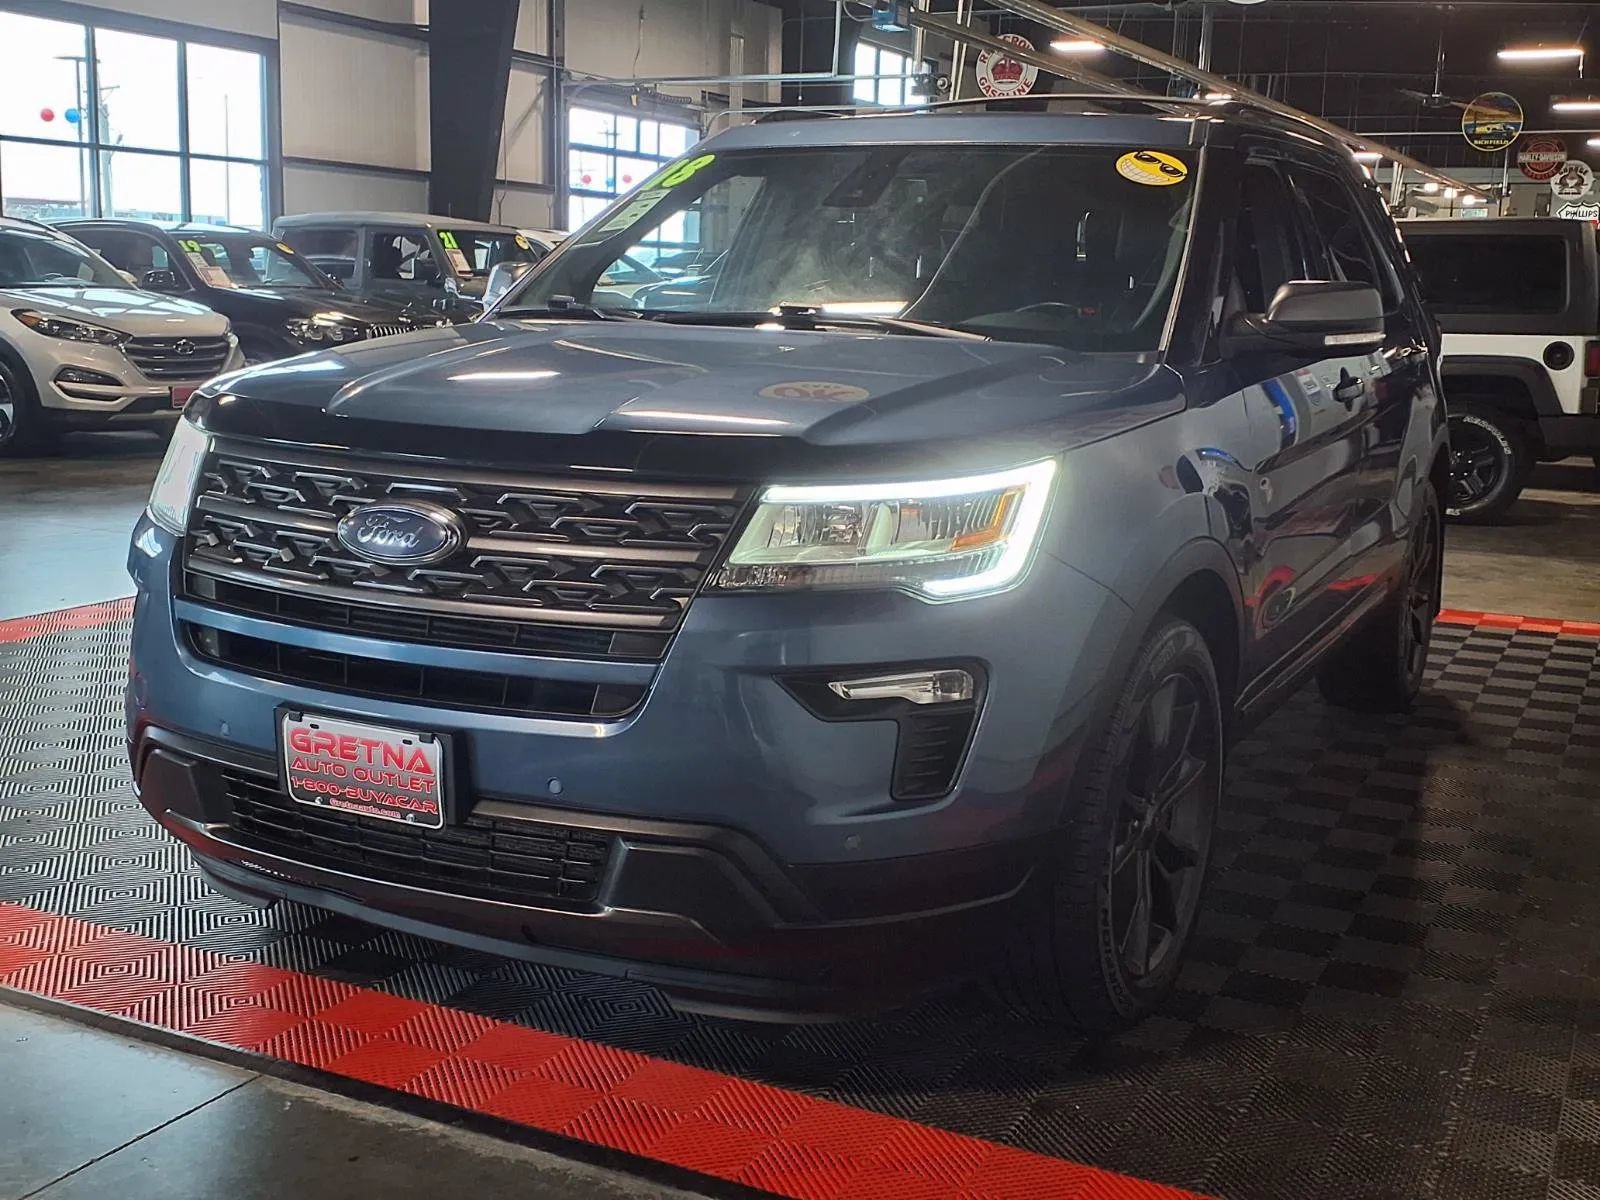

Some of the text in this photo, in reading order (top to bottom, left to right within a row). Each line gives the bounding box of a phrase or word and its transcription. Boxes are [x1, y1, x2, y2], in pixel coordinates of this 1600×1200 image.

[641, 154, 715, 190] 18
[1565, 210, 1598, 218] PHILLIPS
[178, 239, 202, 252] 19
[439, 231, 459, 249] 21
[357, 513, 424, 548] Ford
[288, 726, 435, 775] GRETNA
[290, 756, 437, 794] AUTO OUTLET
[290, 775, 439, 815] 1-800-BUYACAR
